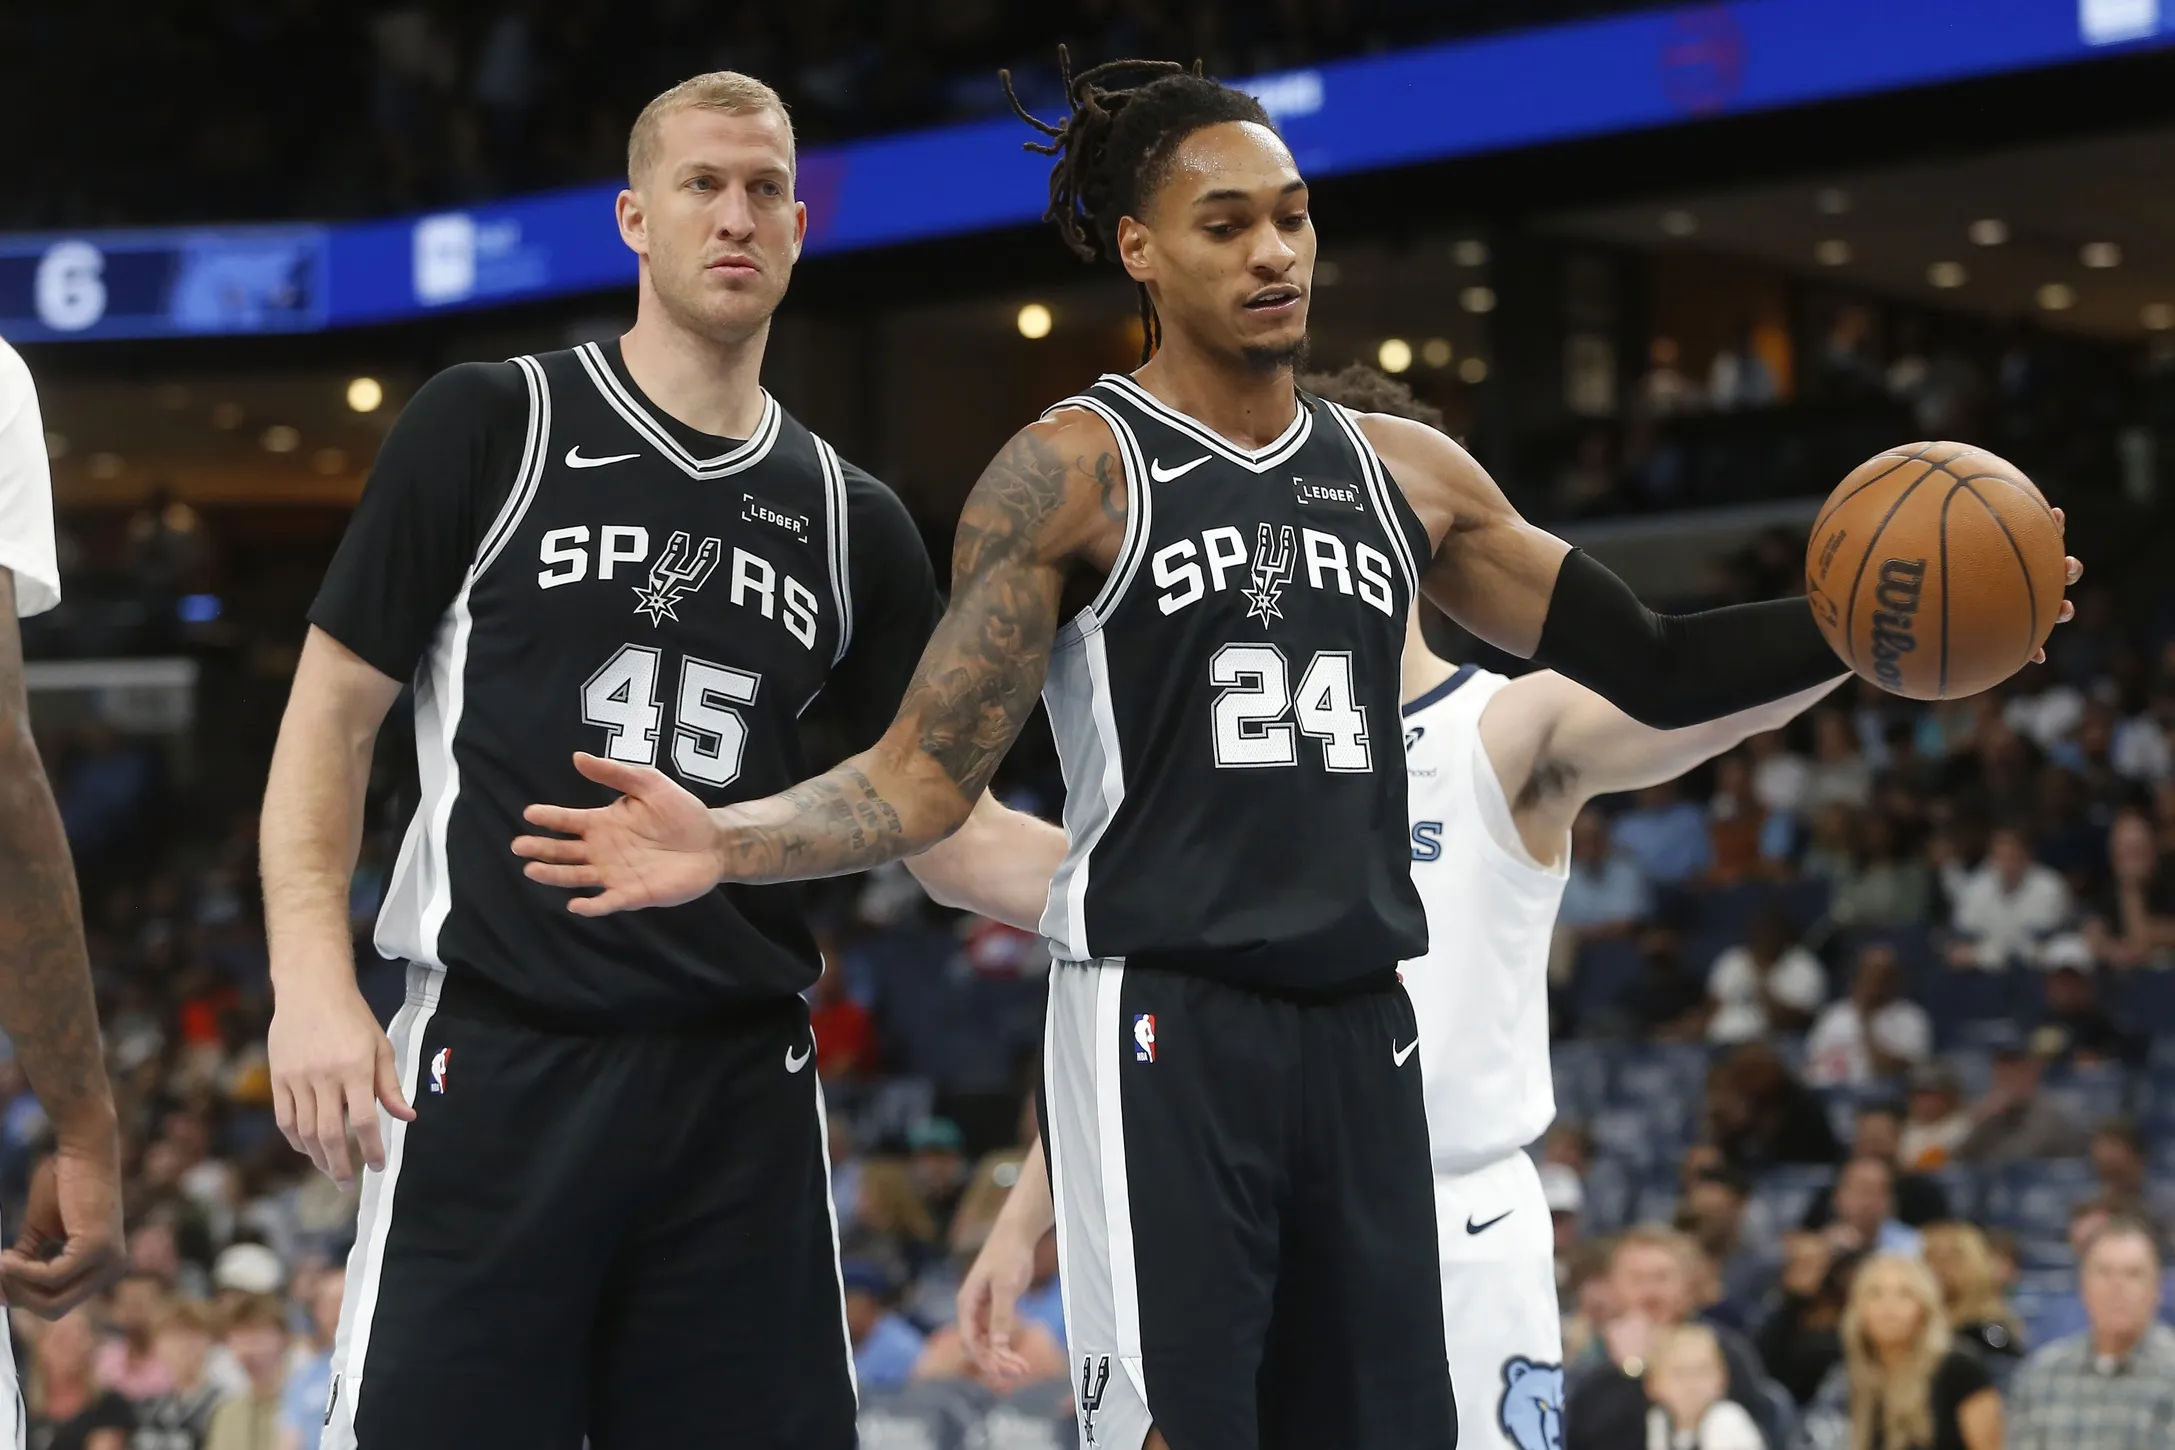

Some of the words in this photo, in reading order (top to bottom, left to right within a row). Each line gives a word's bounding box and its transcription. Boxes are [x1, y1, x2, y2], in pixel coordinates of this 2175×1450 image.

[36, 240, 106, 331] 6
[751, 504, 801, 533] LEDGER
[1303, 485, 1355, 503] LEDGER
[538, 525, 819, 650] SPURS
[1151, 522, 1393, 629] SPURS
[580, 642, 762, 788] 45
[1209, 642, 1374, 773] 24
